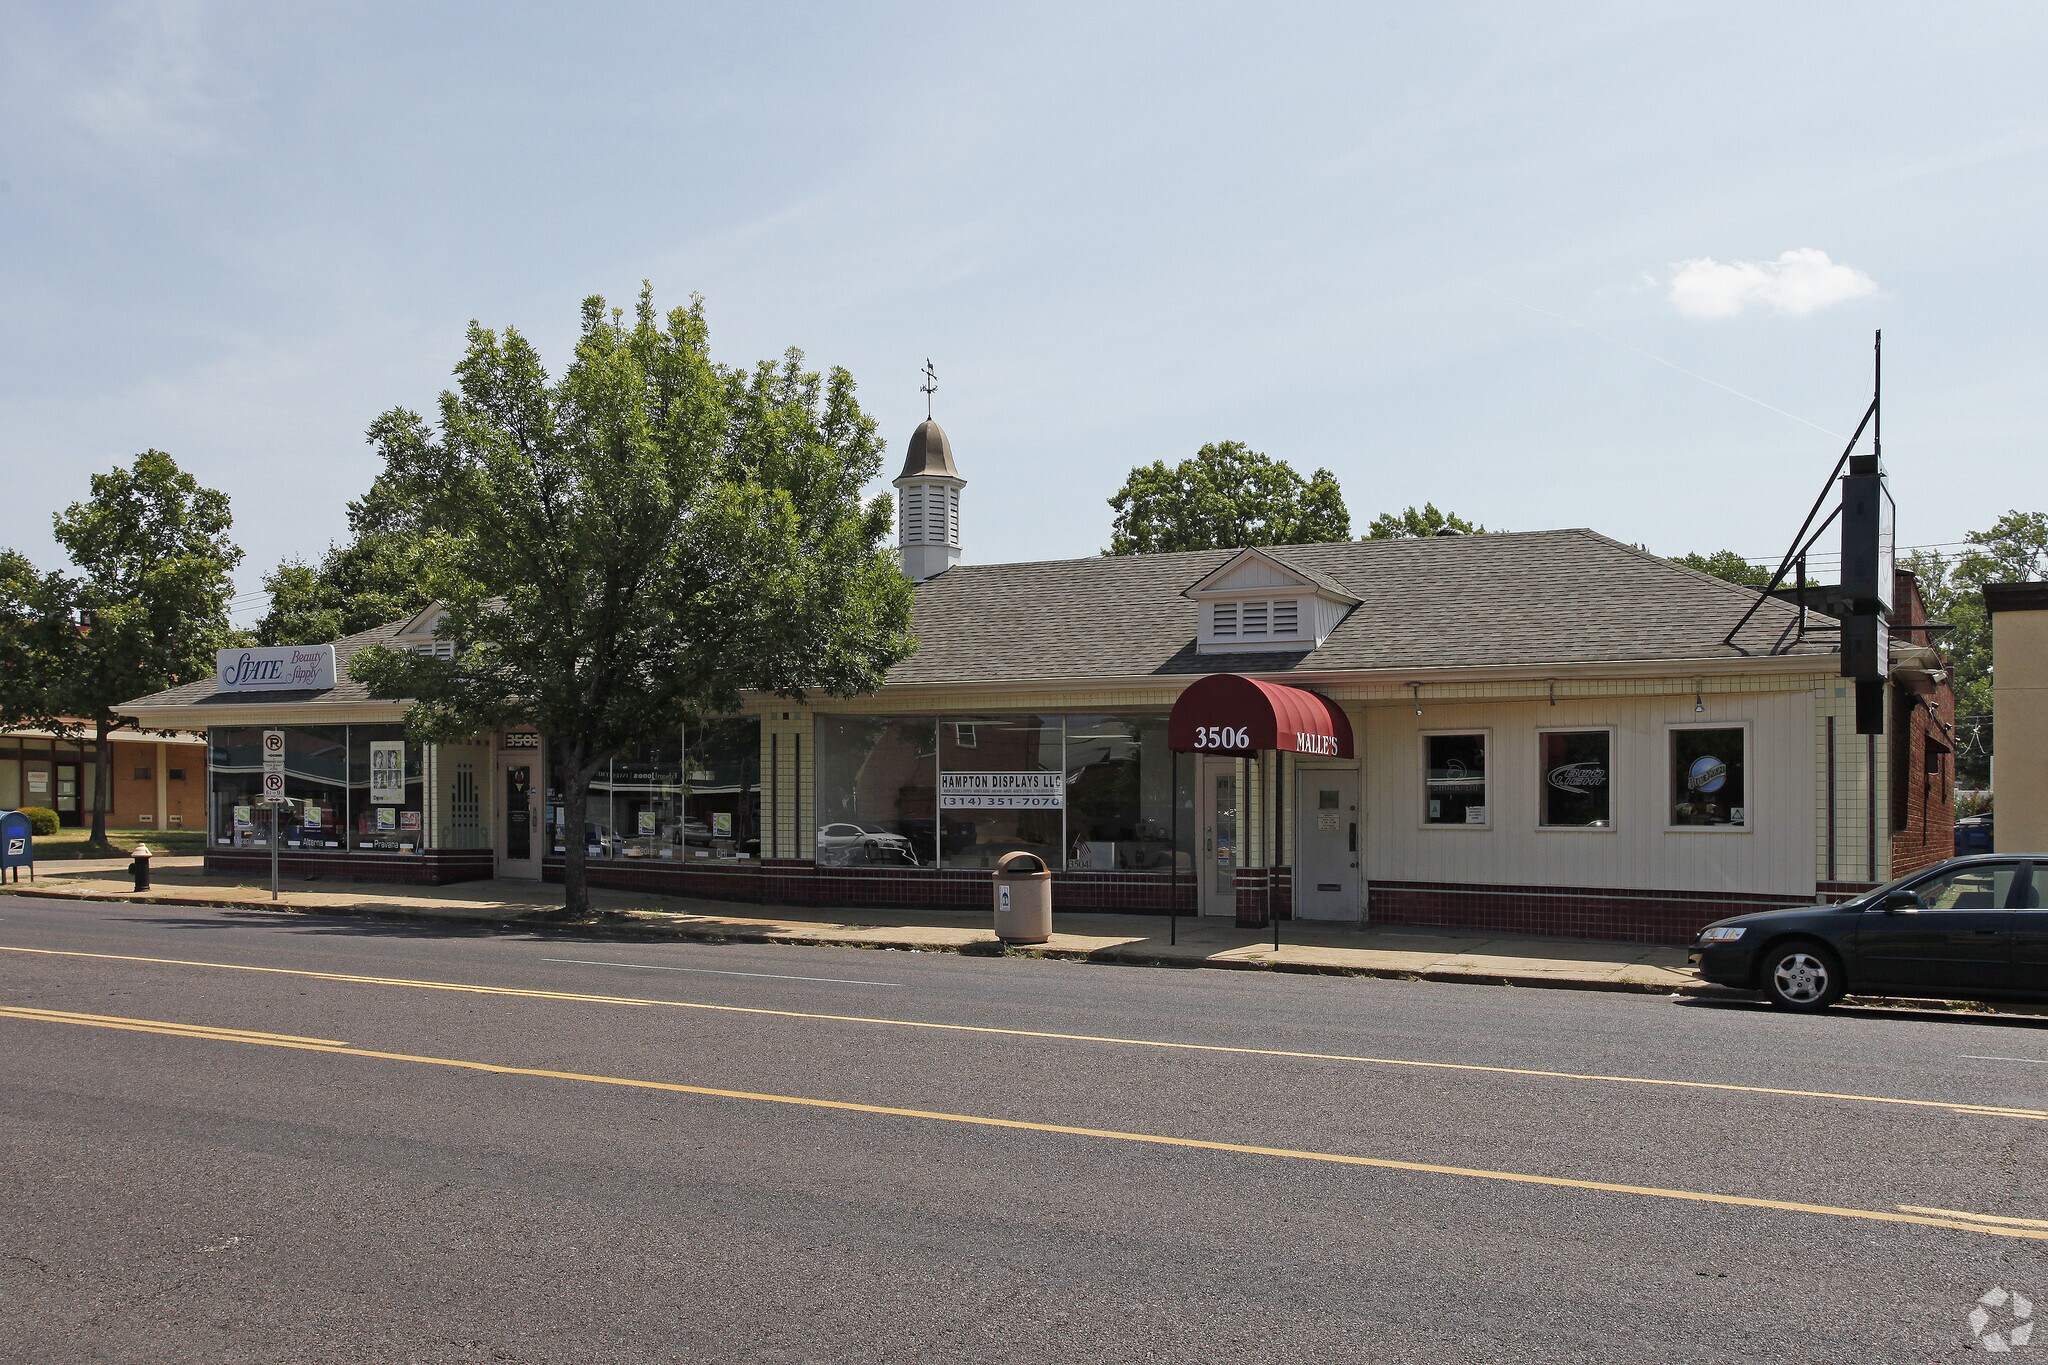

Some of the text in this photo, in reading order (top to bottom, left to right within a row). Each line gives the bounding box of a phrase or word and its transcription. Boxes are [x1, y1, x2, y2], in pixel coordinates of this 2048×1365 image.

[290, 650, 327, 668] Beauty
[223, 653, 284, 686] STATE
[286, 665, 322, 685] Supply
[507, 734, 538, 747] 3502
[1193, 726, 1250, 749] 3506
[1296, 732, 1338, 755] MALLE'S
[1565, 769, 1605, 778] BUD
[942, 775, 1062, 788] HAMPTON DISPLAYS LLC
[1555, 776, 1606, 785] LIGHT
[943, 797, 1060, 806] (314) 351-7070
[303, 838, 324, 847] Alterna
[1067, 859, 1088, 869] 3504
